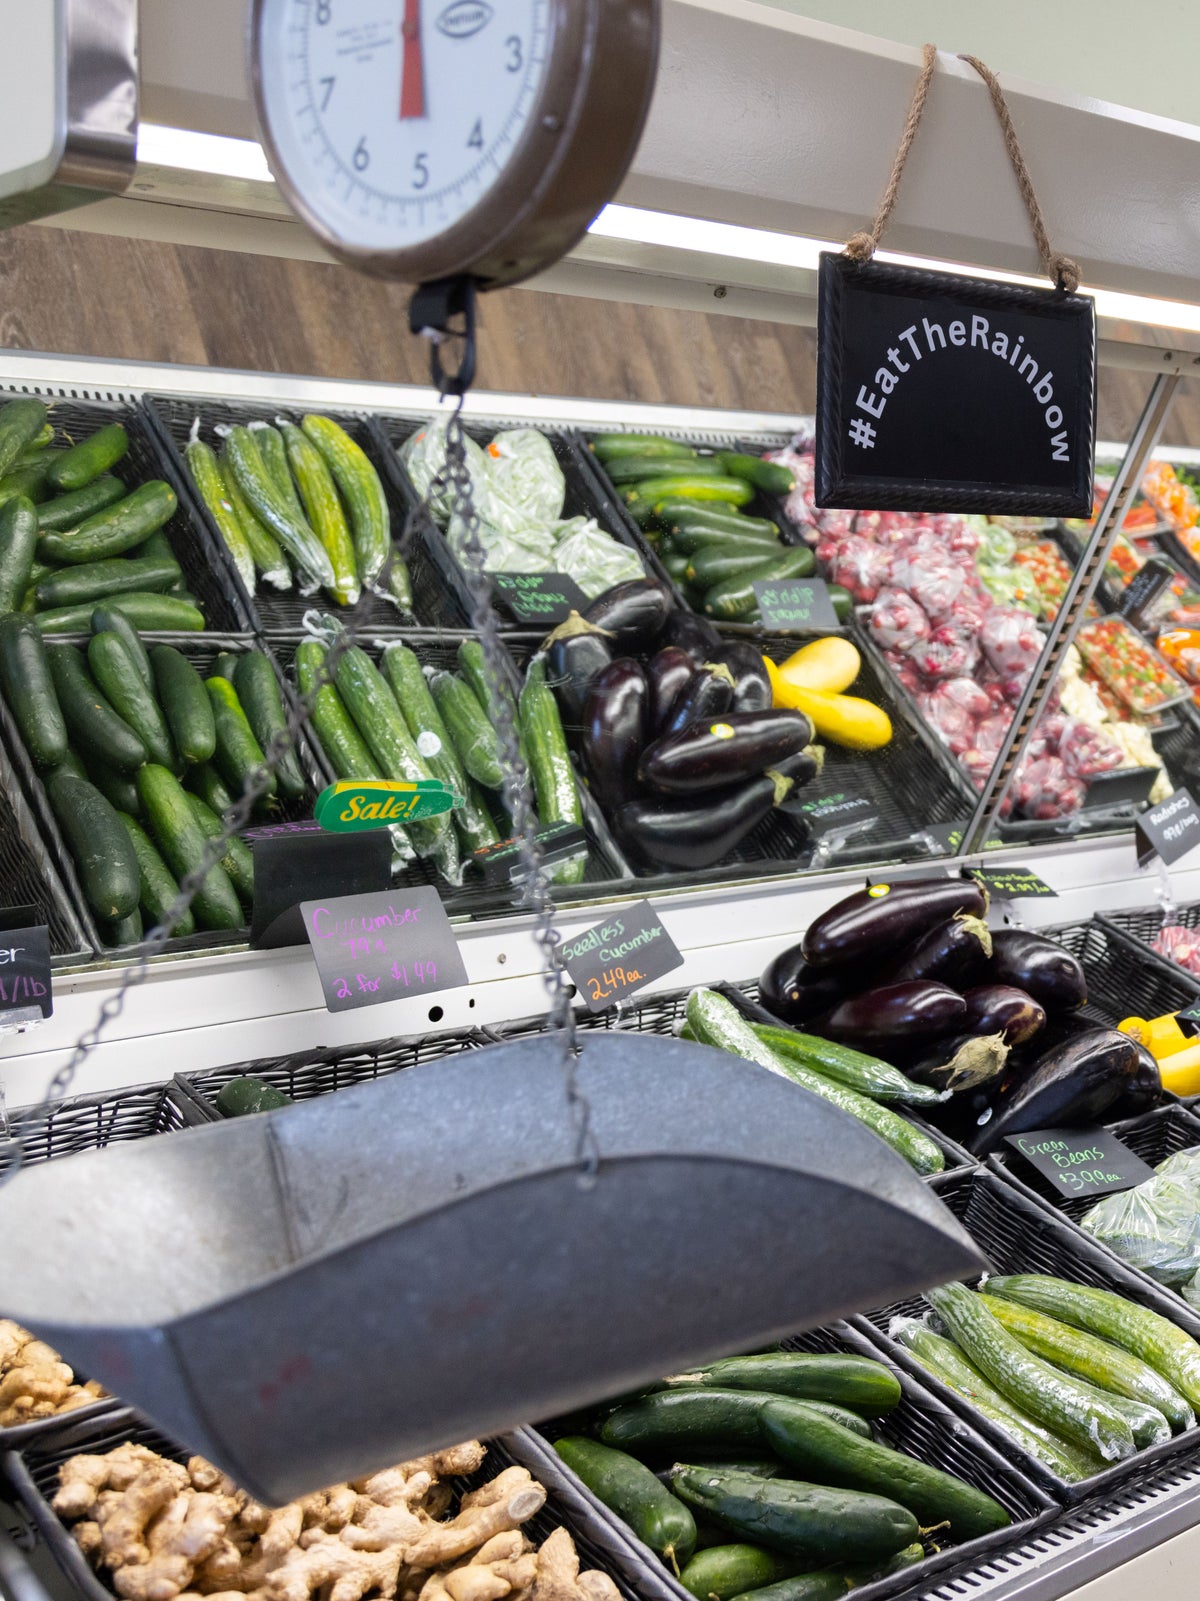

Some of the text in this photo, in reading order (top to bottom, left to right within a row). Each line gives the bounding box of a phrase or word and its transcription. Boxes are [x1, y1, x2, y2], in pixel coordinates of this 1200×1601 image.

[505, 35, 523, 73] 3
[319, 76, 336, 112] 7
[466, 117, 484, 151] 4
[352, 136, 370, 172] 6
[412, 153, 429, 189] 5
[848, 314, 1070, 462] #EatTheRainbow
[339, 795, 421, 822] Sale!
[313, 906, 421, 938] Cucumber
[562, 919, 625, 961] Seedless
[599, 926, 662, 962] Cucumber
[333, 978, 352, 999] 2
[356, 974, 381, 992] for
[1018, 1139, 1069, 1156] Green
[1051, 1147, 1104, 1168] Beans
